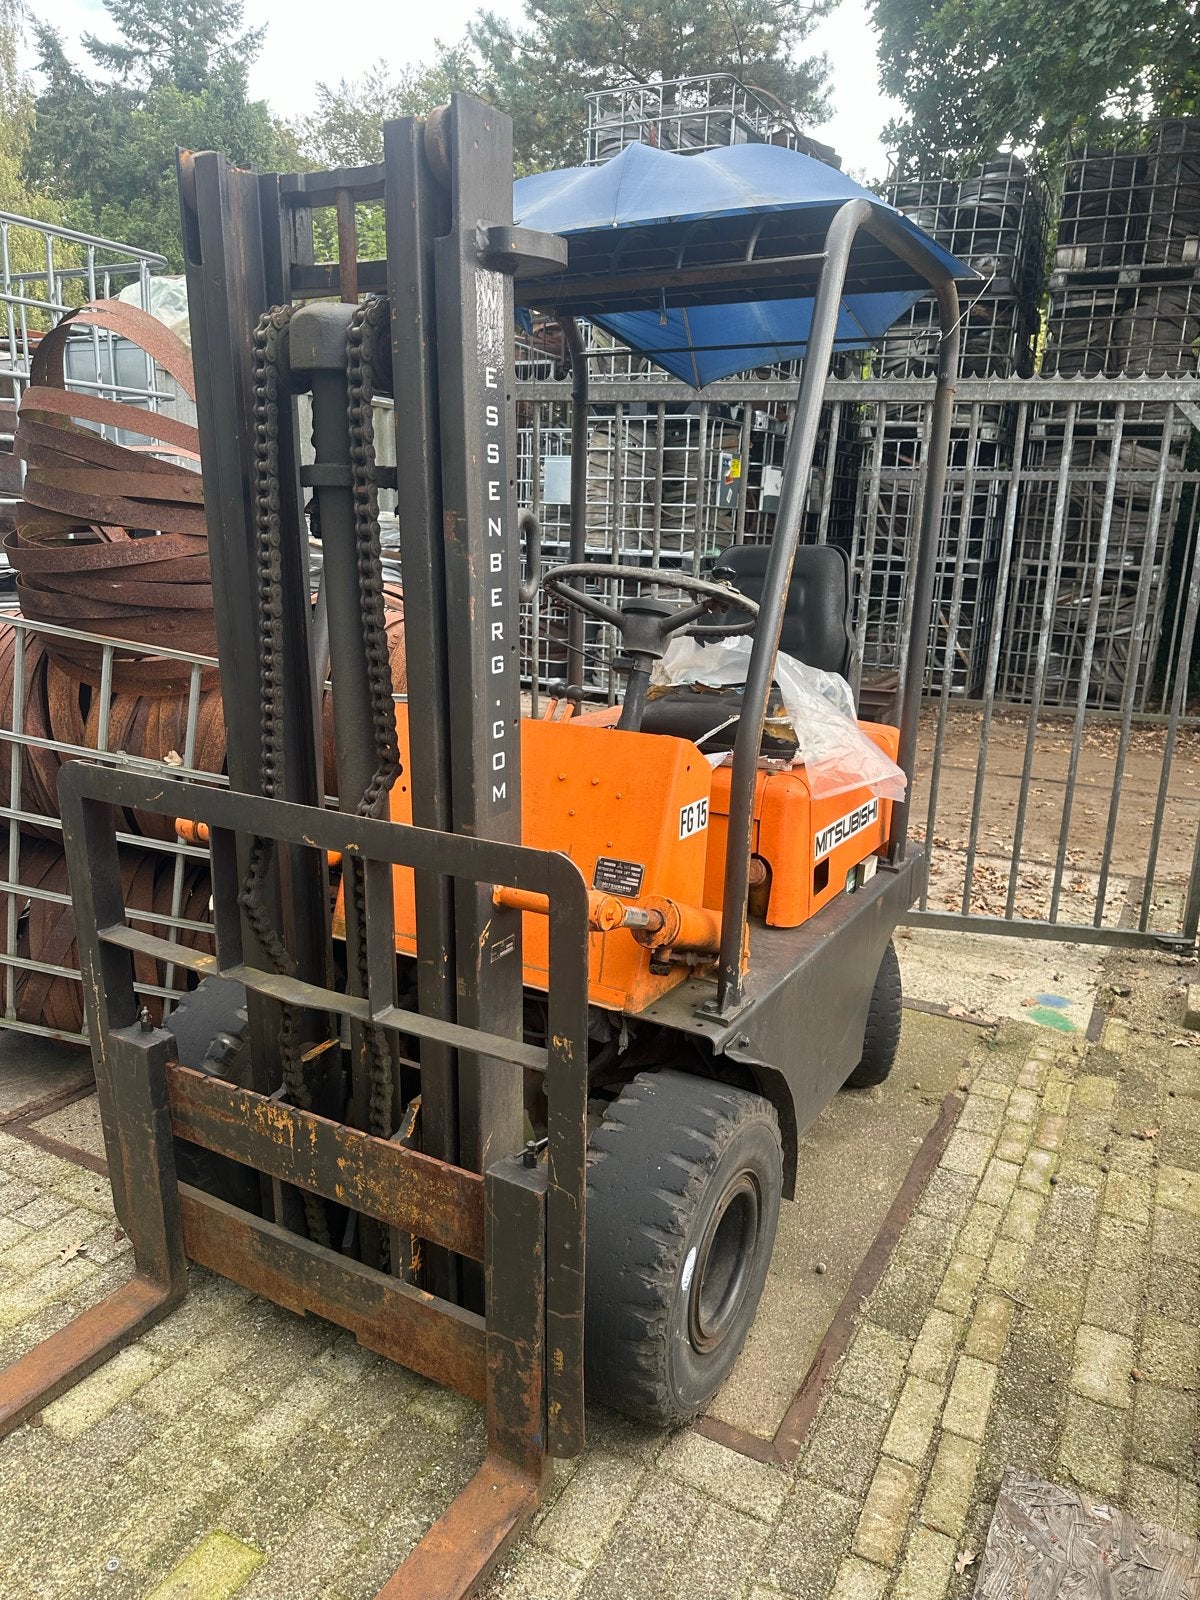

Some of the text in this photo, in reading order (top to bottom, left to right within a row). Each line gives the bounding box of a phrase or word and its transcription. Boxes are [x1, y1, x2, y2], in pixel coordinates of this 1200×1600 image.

[680, 800, 707, 836] FG 15
[815, 799, 878, 857] MITSUBISHI
